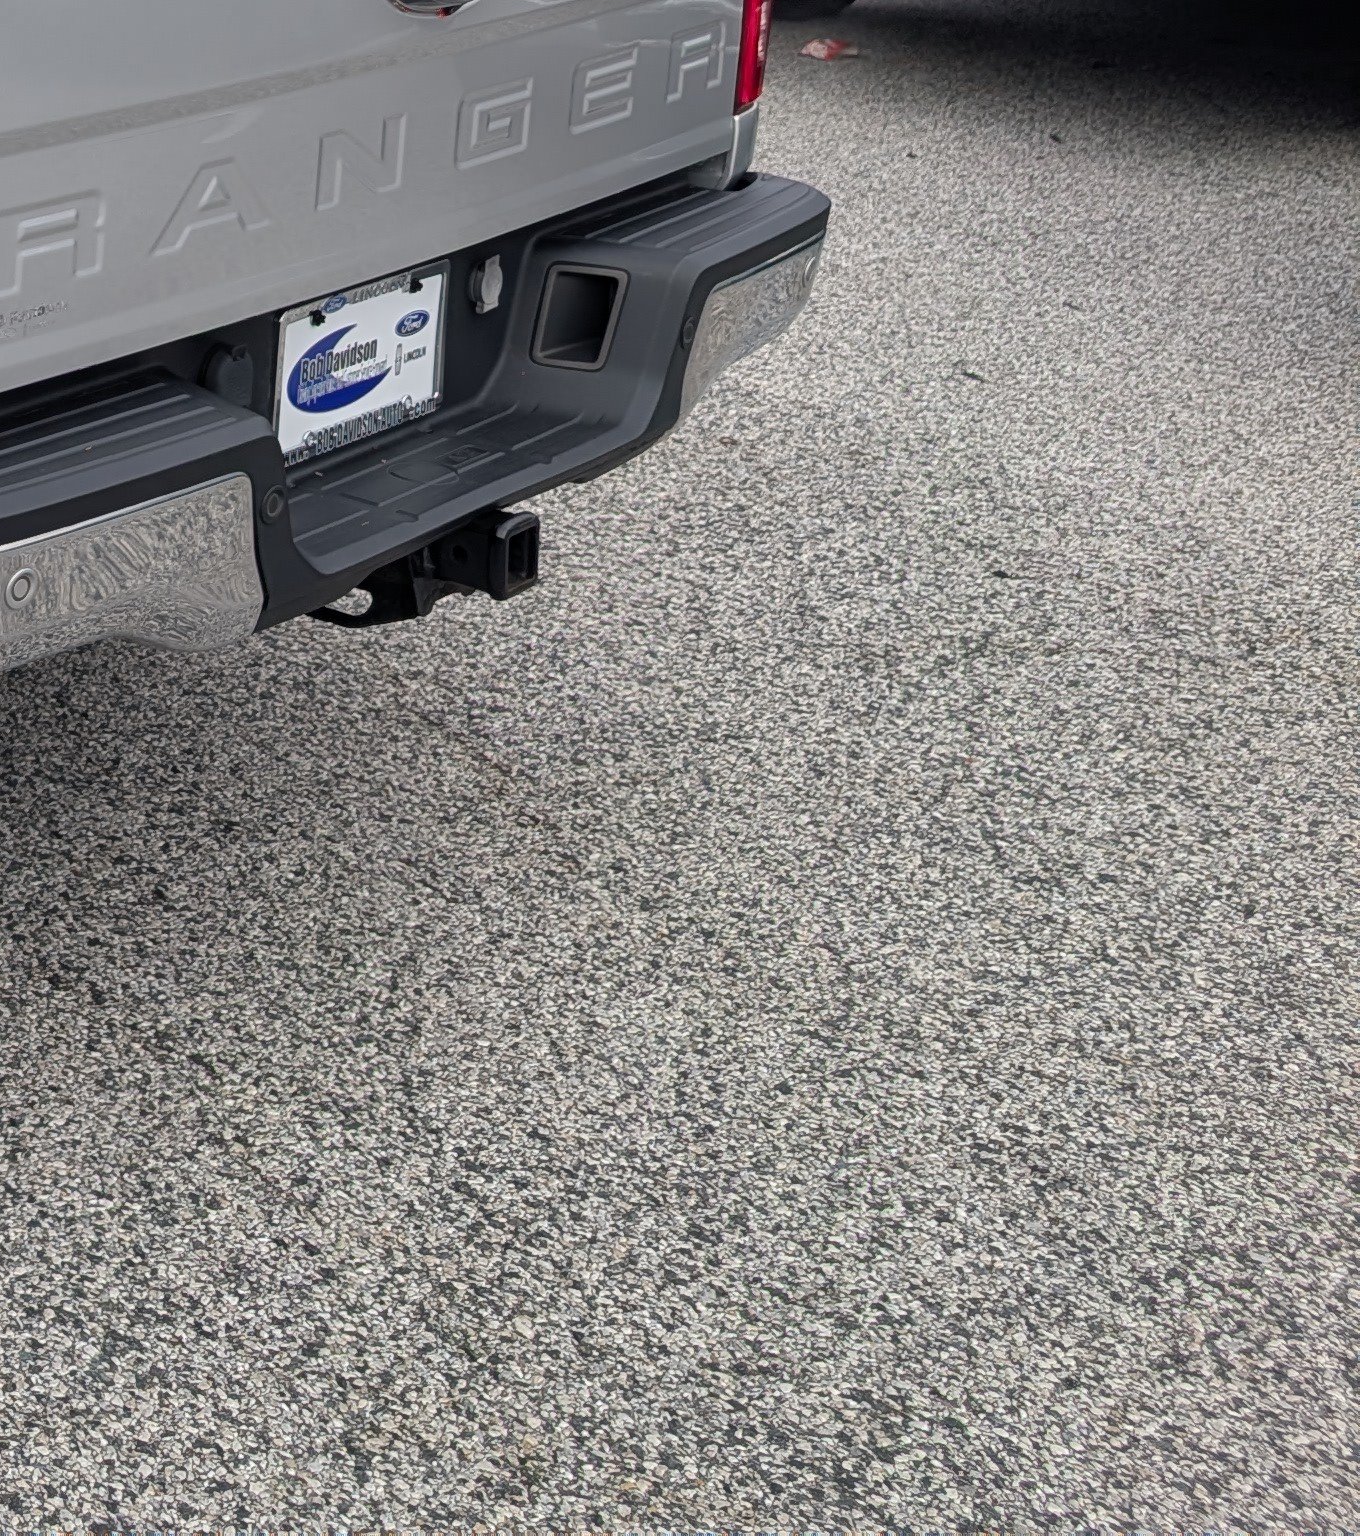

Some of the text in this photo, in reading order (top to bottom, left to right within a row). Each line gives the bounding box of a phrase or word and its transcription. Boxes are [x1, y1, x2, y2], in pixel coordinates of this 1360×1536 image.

[300, 354, 326, 383] Bob
[326, 338, 378, 374] Davidson
[404, 346, 427, 364] LINCOLN
[315, 429, 338, 455] BOB
[337, 411, 379, 449] DAVIDSON
[380, 401, 405, 432] AUTO
